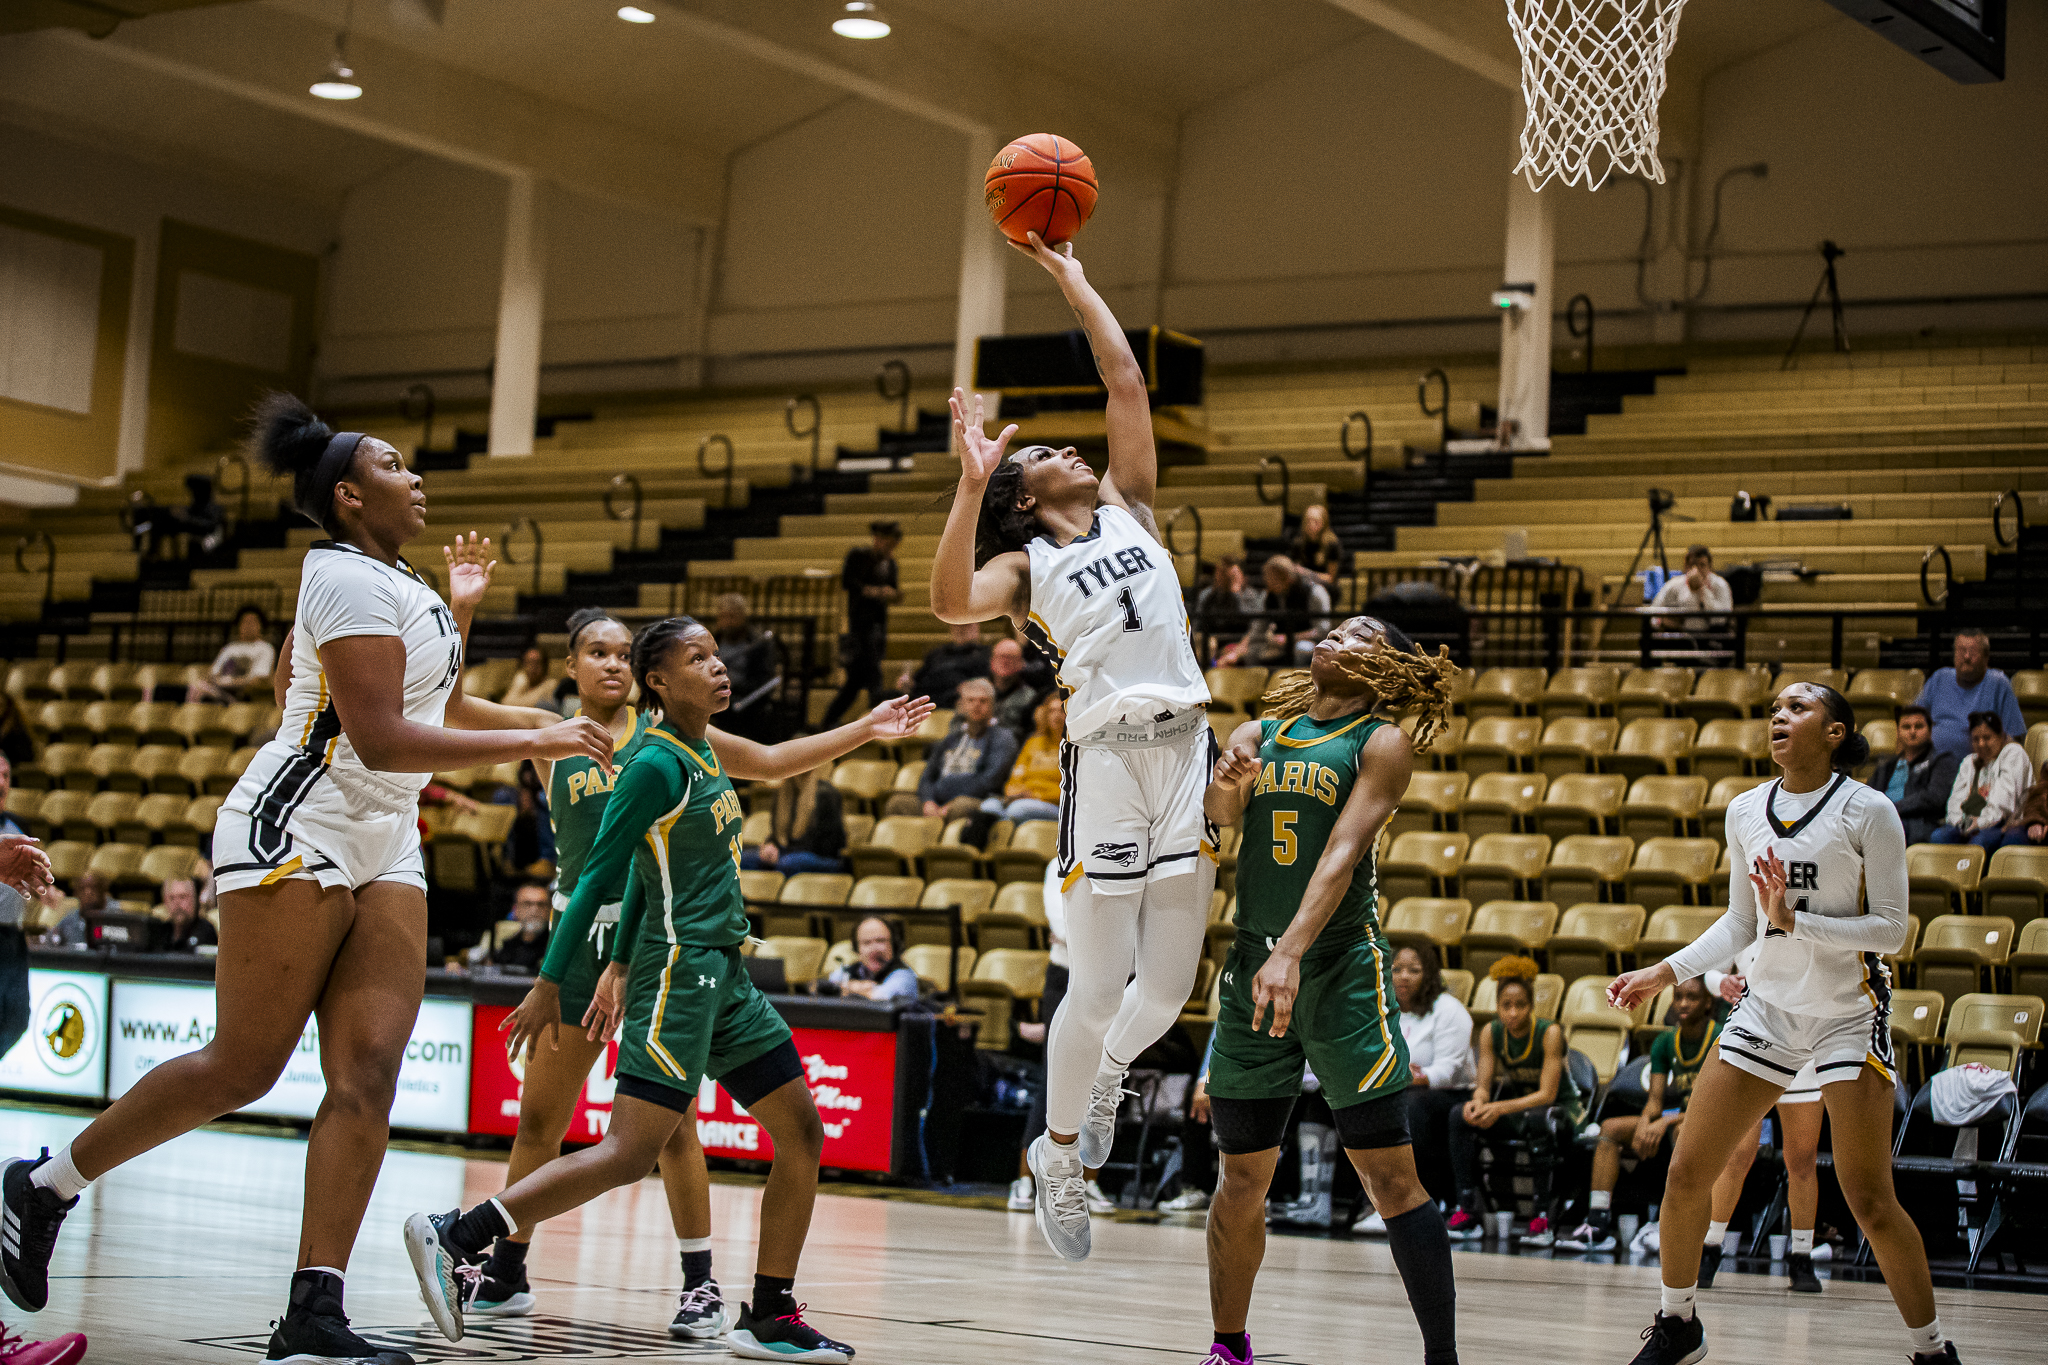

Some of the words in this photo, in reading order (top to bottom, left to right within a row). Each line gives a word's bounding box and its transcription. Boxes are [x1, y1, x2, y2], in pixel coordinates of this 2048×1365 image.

[1066, 545, 1157, 599] TYLER
[1116, 585, 1143, 632] 1
[567, 764, 624, 805] PAR
[1252, 760, 1339, 806] ARIS
[710, 789, 742, 835] PARI
[1272, 810, 1298, 865] 5
